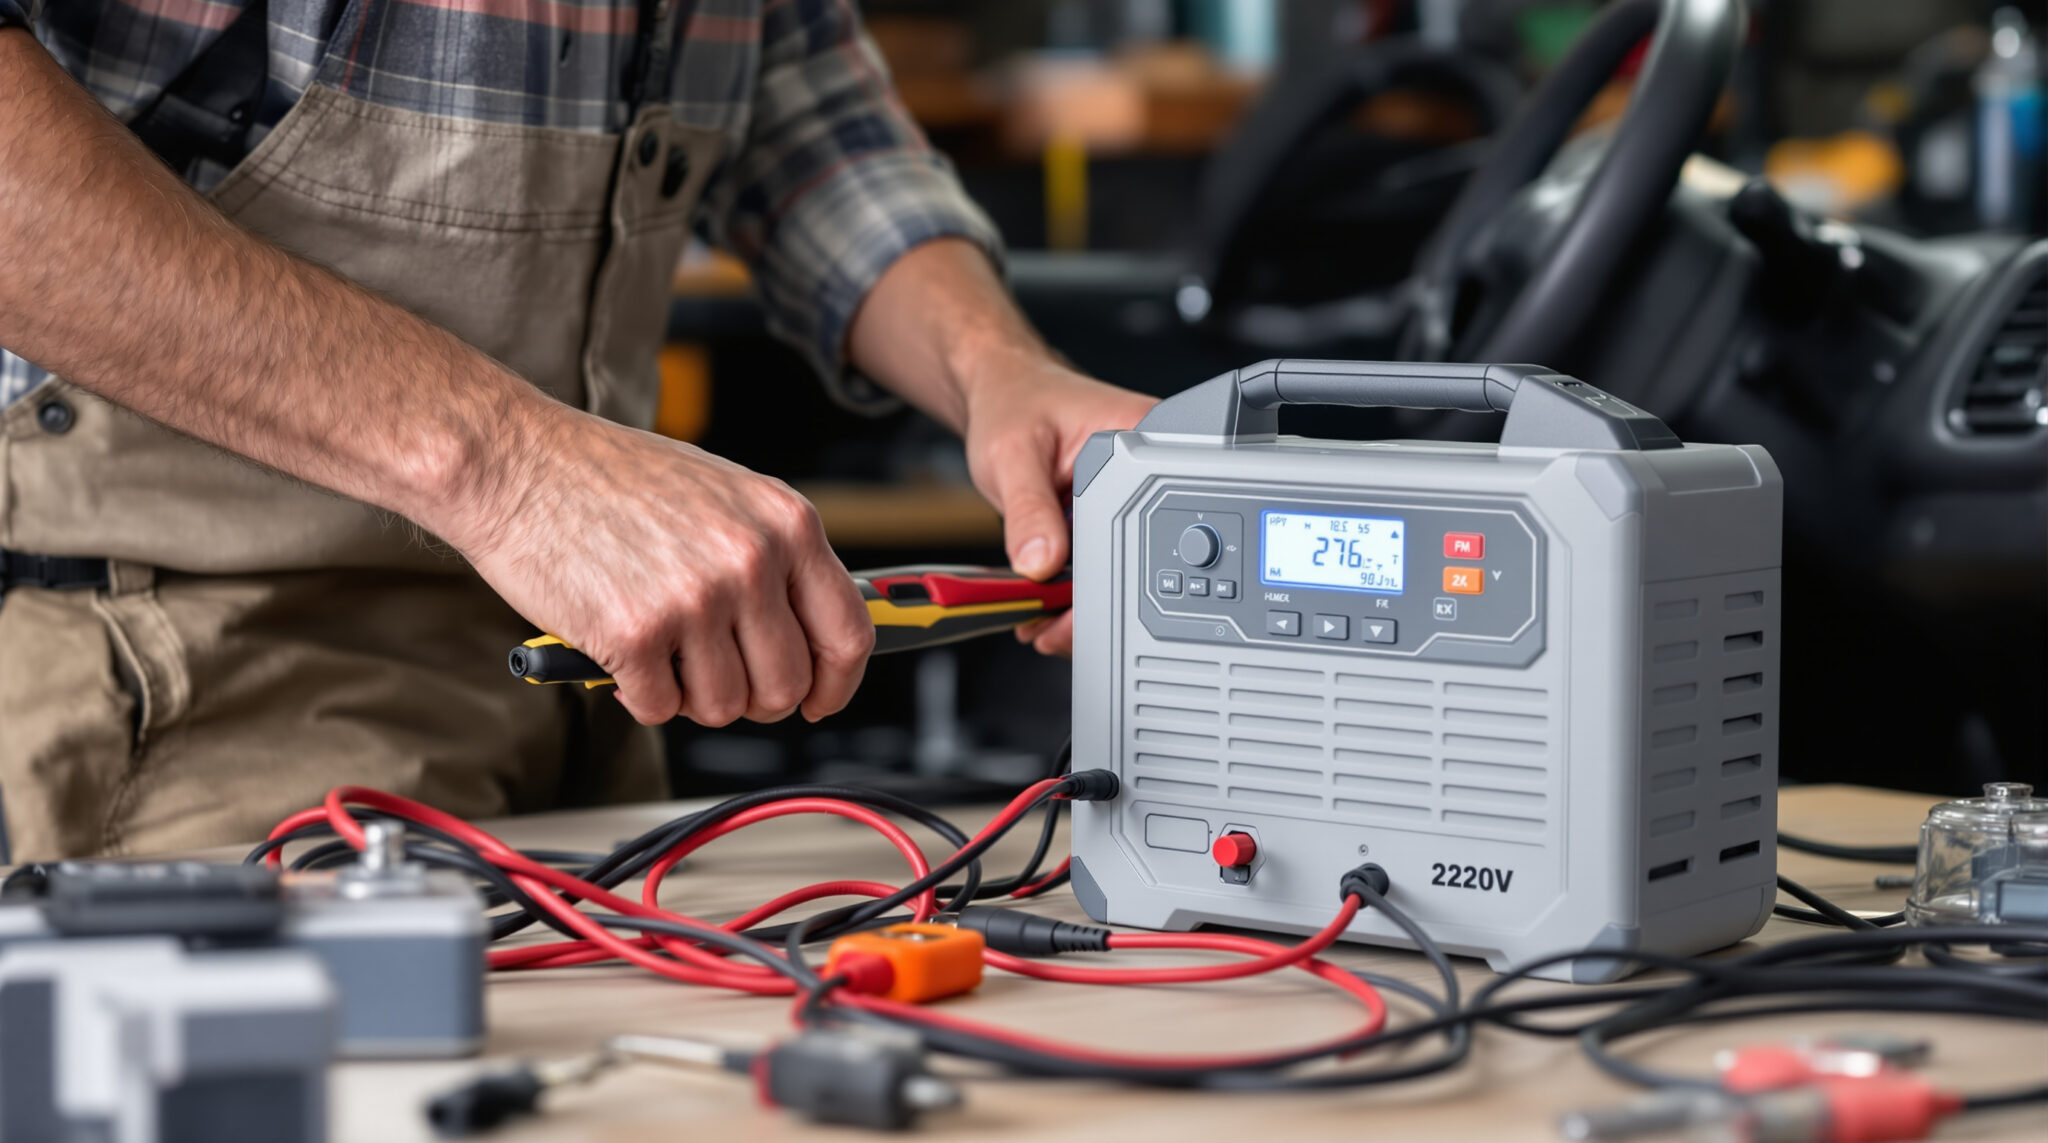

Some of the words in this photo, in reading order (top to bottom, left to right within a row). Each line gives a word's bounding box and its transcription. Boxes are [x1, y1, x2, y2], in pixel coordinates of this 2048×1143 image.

[1312, 537, 1362, 568] 276
[1454, 539, 1471, 553] FM
[1431, 862, 1514, 893] 2220V
